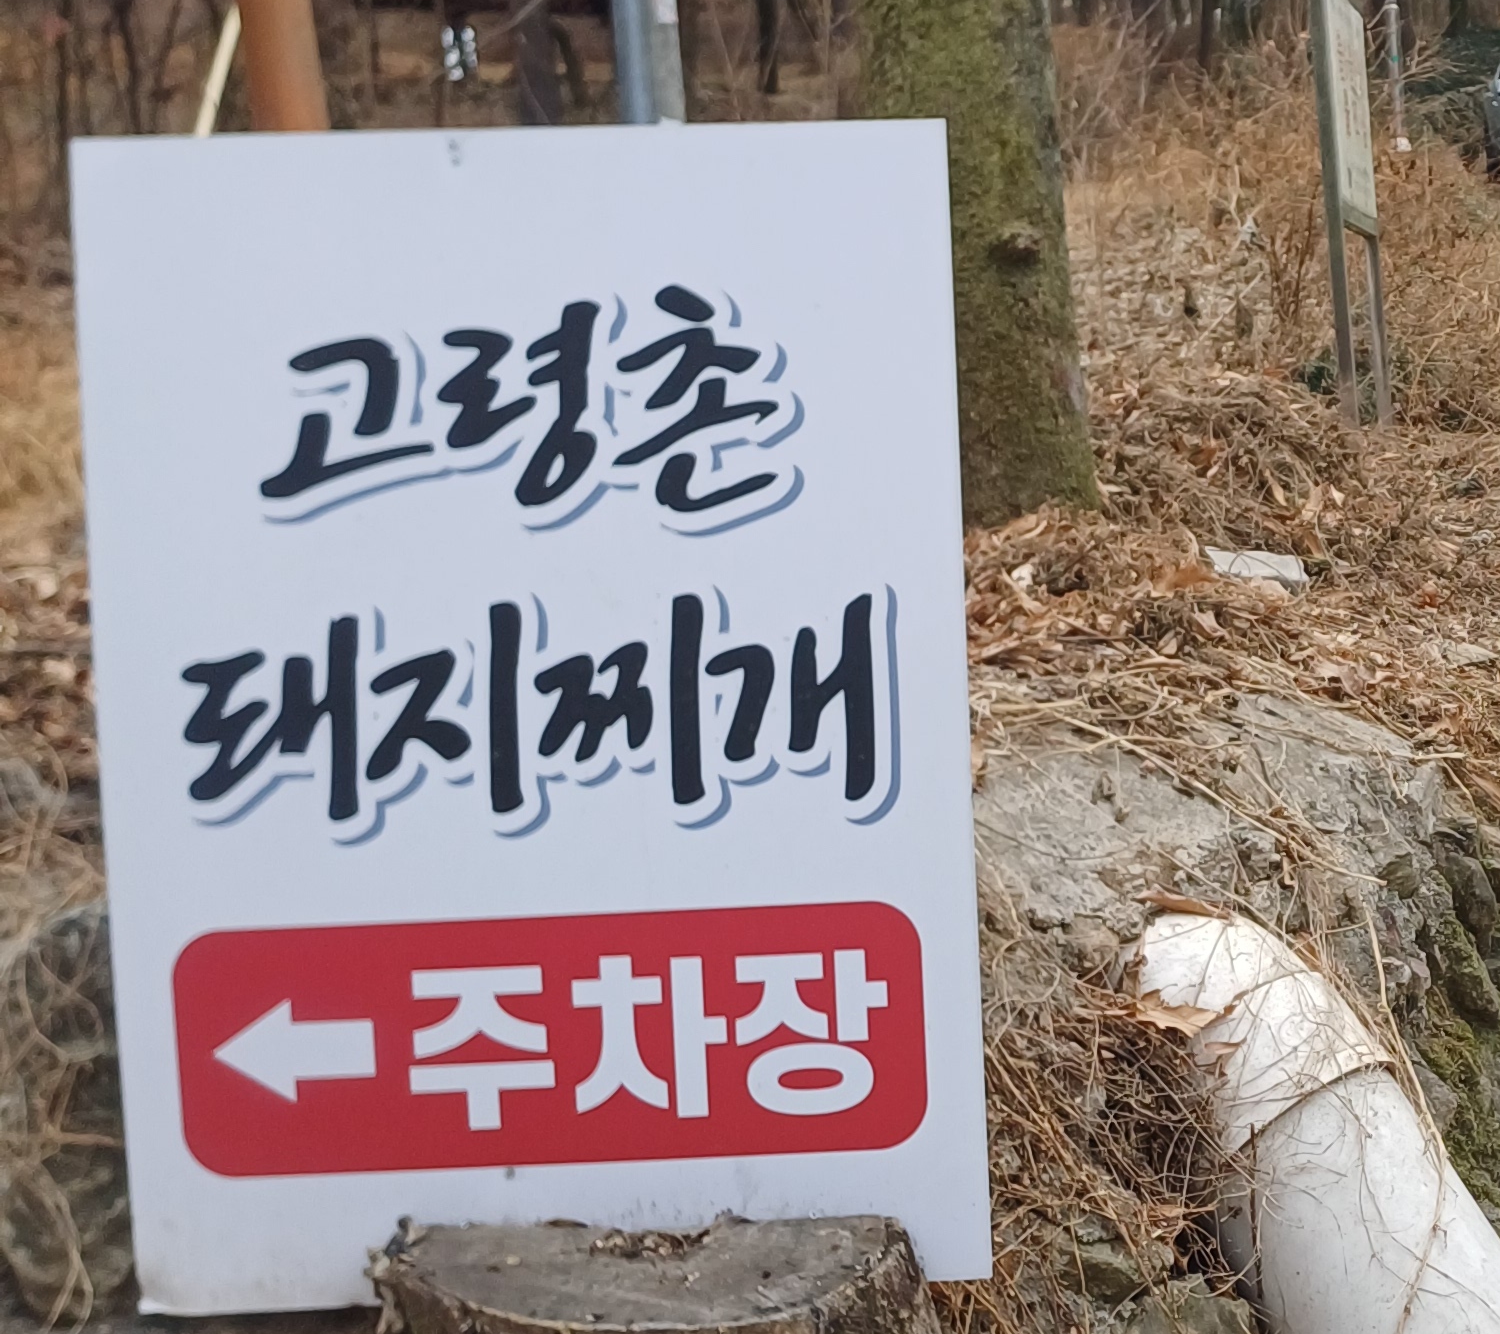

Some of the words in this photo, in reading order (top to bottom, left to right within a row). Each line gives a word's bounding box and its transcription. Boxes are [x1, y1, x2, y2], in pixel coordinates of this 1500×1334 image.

[260, 283, 790, 527] 고령촌
[181, 591, 898, 832] 돼지찌개
[407, 948, 890, 1130] 주차장
